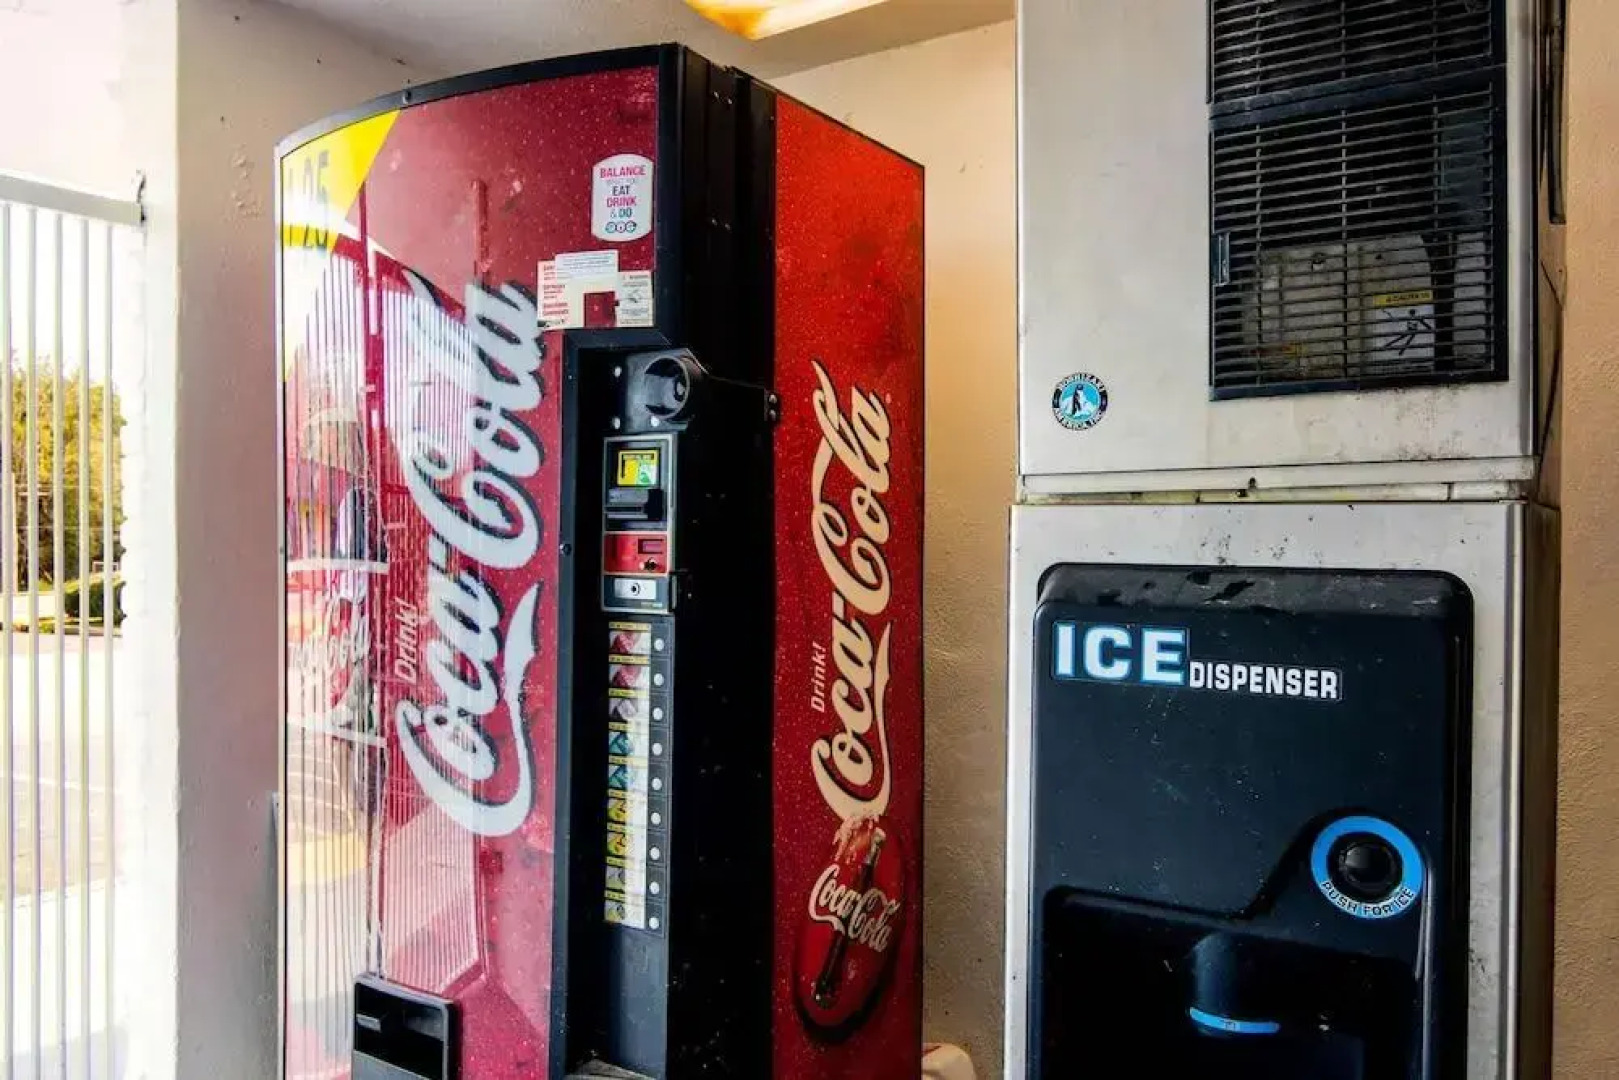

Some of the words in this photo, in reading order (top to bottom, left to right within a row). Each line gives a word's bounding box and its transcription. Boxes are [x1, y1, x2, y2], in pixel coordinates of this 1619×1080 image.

[600, 165, 646, 178] BALANCE
[606, 196, 637, 208] DRINK
[612, 185, 630, 197] EAT
[396, 266, 546, 837] Coca-Cola
[811, 360, 891, 820] Coca-Cola
[394, 597, 419, 682] Drink!
[1056, 623, 1186, 684] ICE
[1189, 661, 1338, 699] DISPENSER
[810, 641, 829, 713] Drink!
[1320, 881, 1358, 914] PUSH
[1363, 903, 1393, 917] FOR
[1393, 888, 1415, 909] ICE
